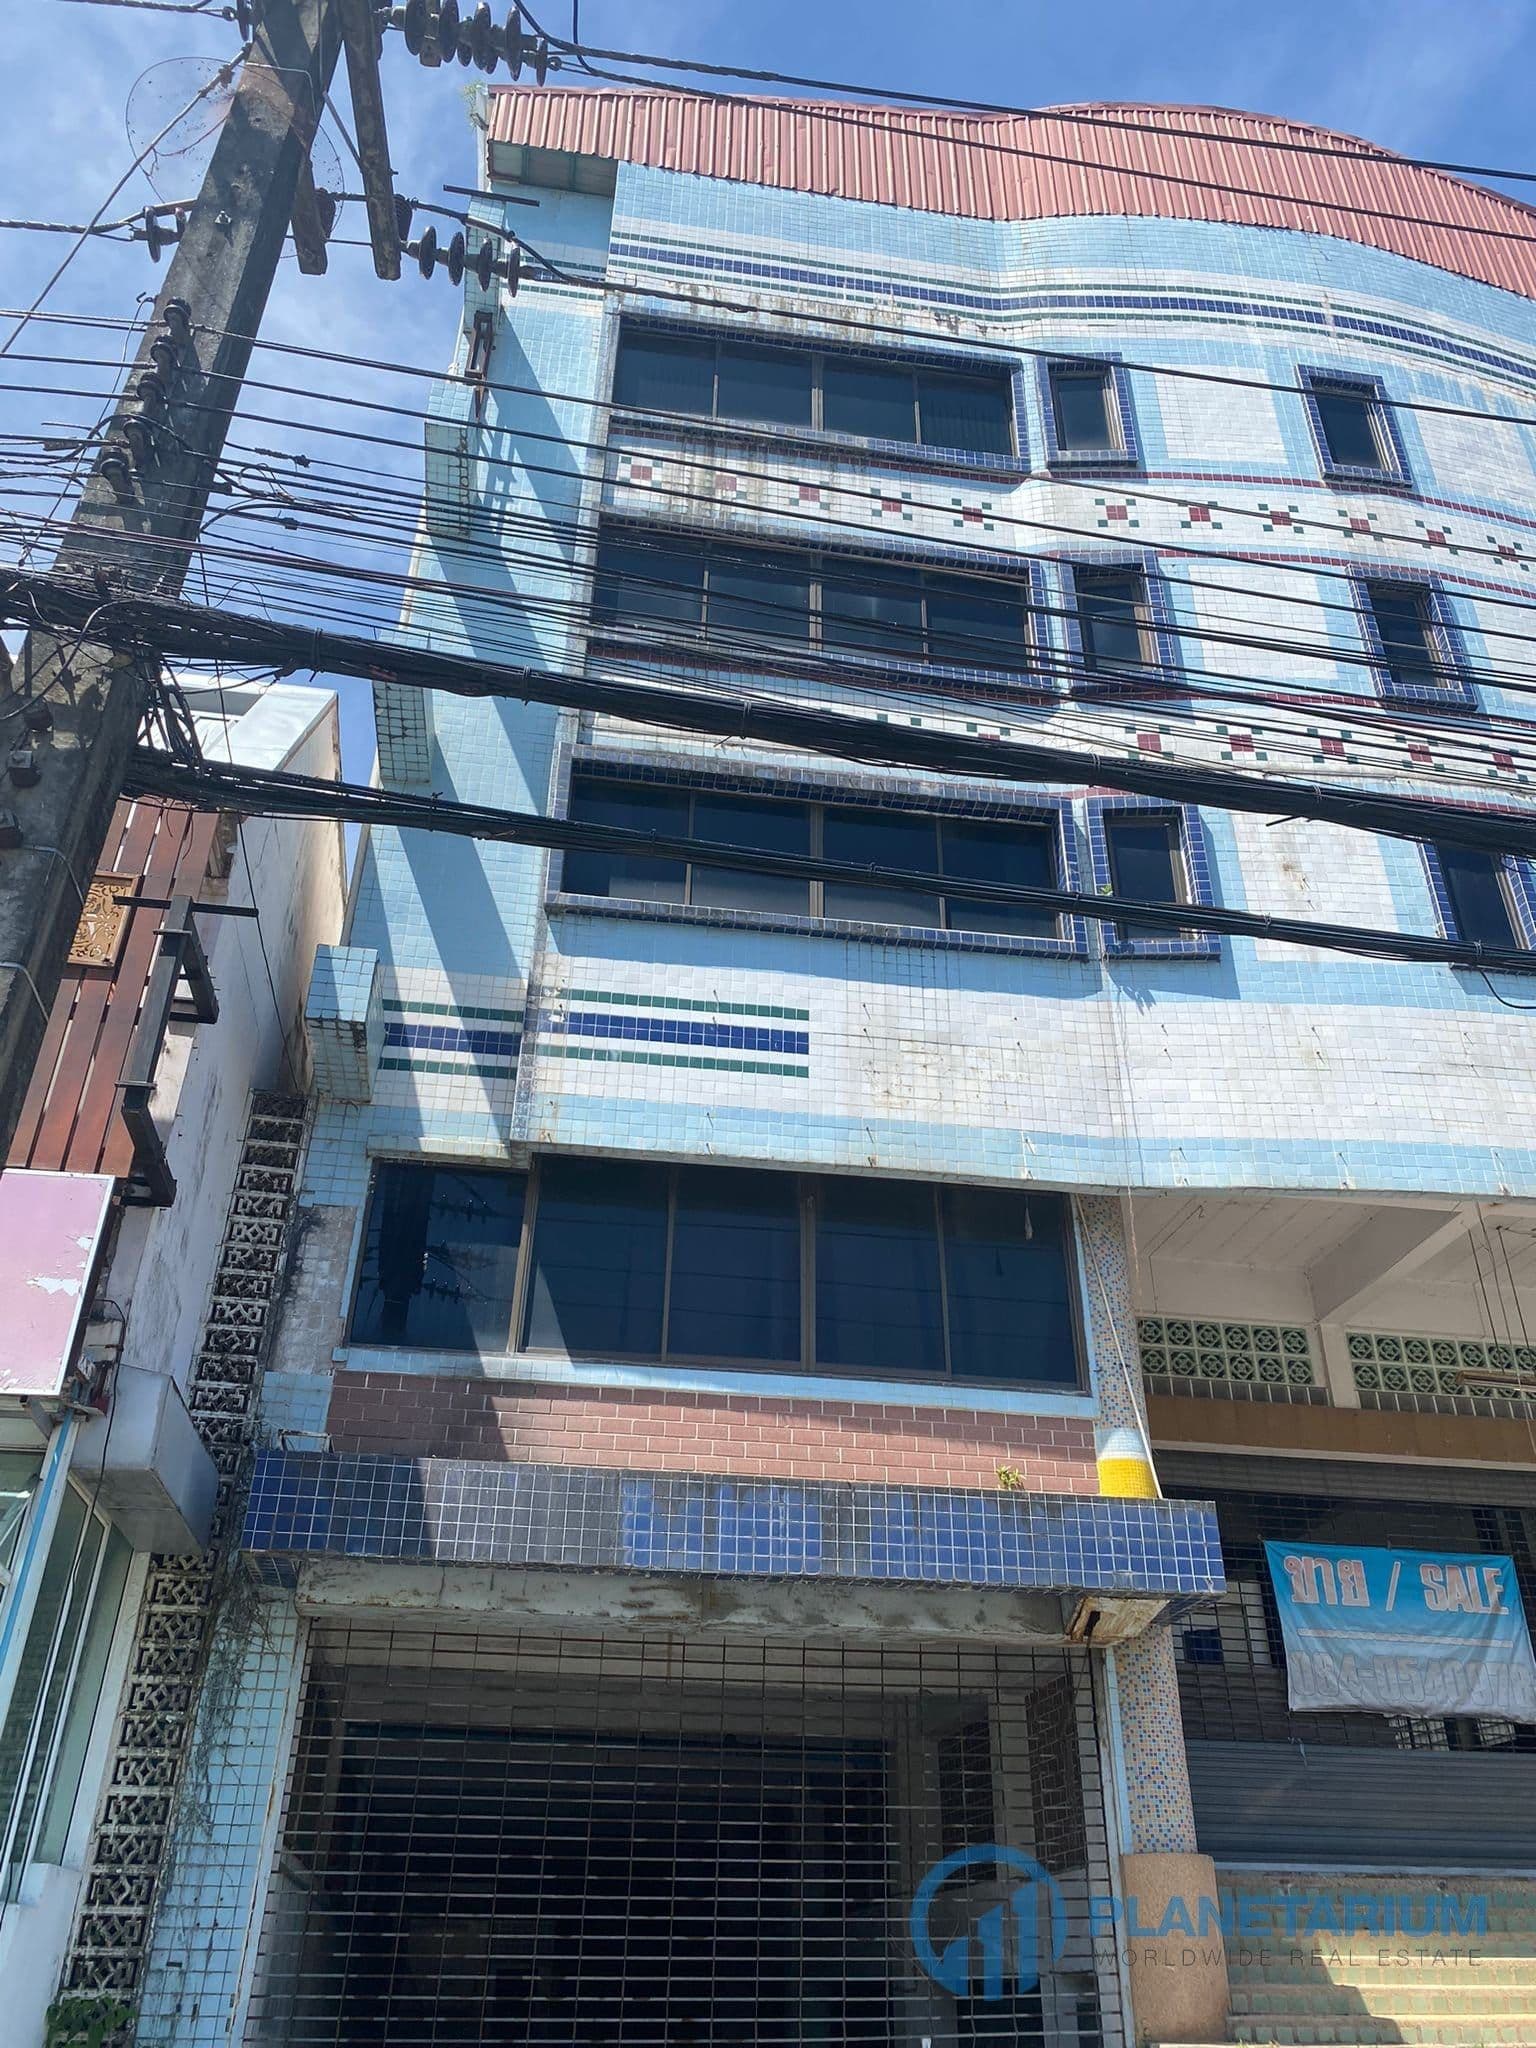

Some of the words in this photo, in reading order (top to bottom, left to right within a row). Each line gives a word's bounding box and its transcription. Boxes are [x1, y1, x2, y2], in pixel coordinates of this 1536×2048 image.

[1283, 1555, 1371, 1607] ขาย
[1386, 1561, 1401, 1612] /
[1419, 1563, 1510, 1616] SALE
